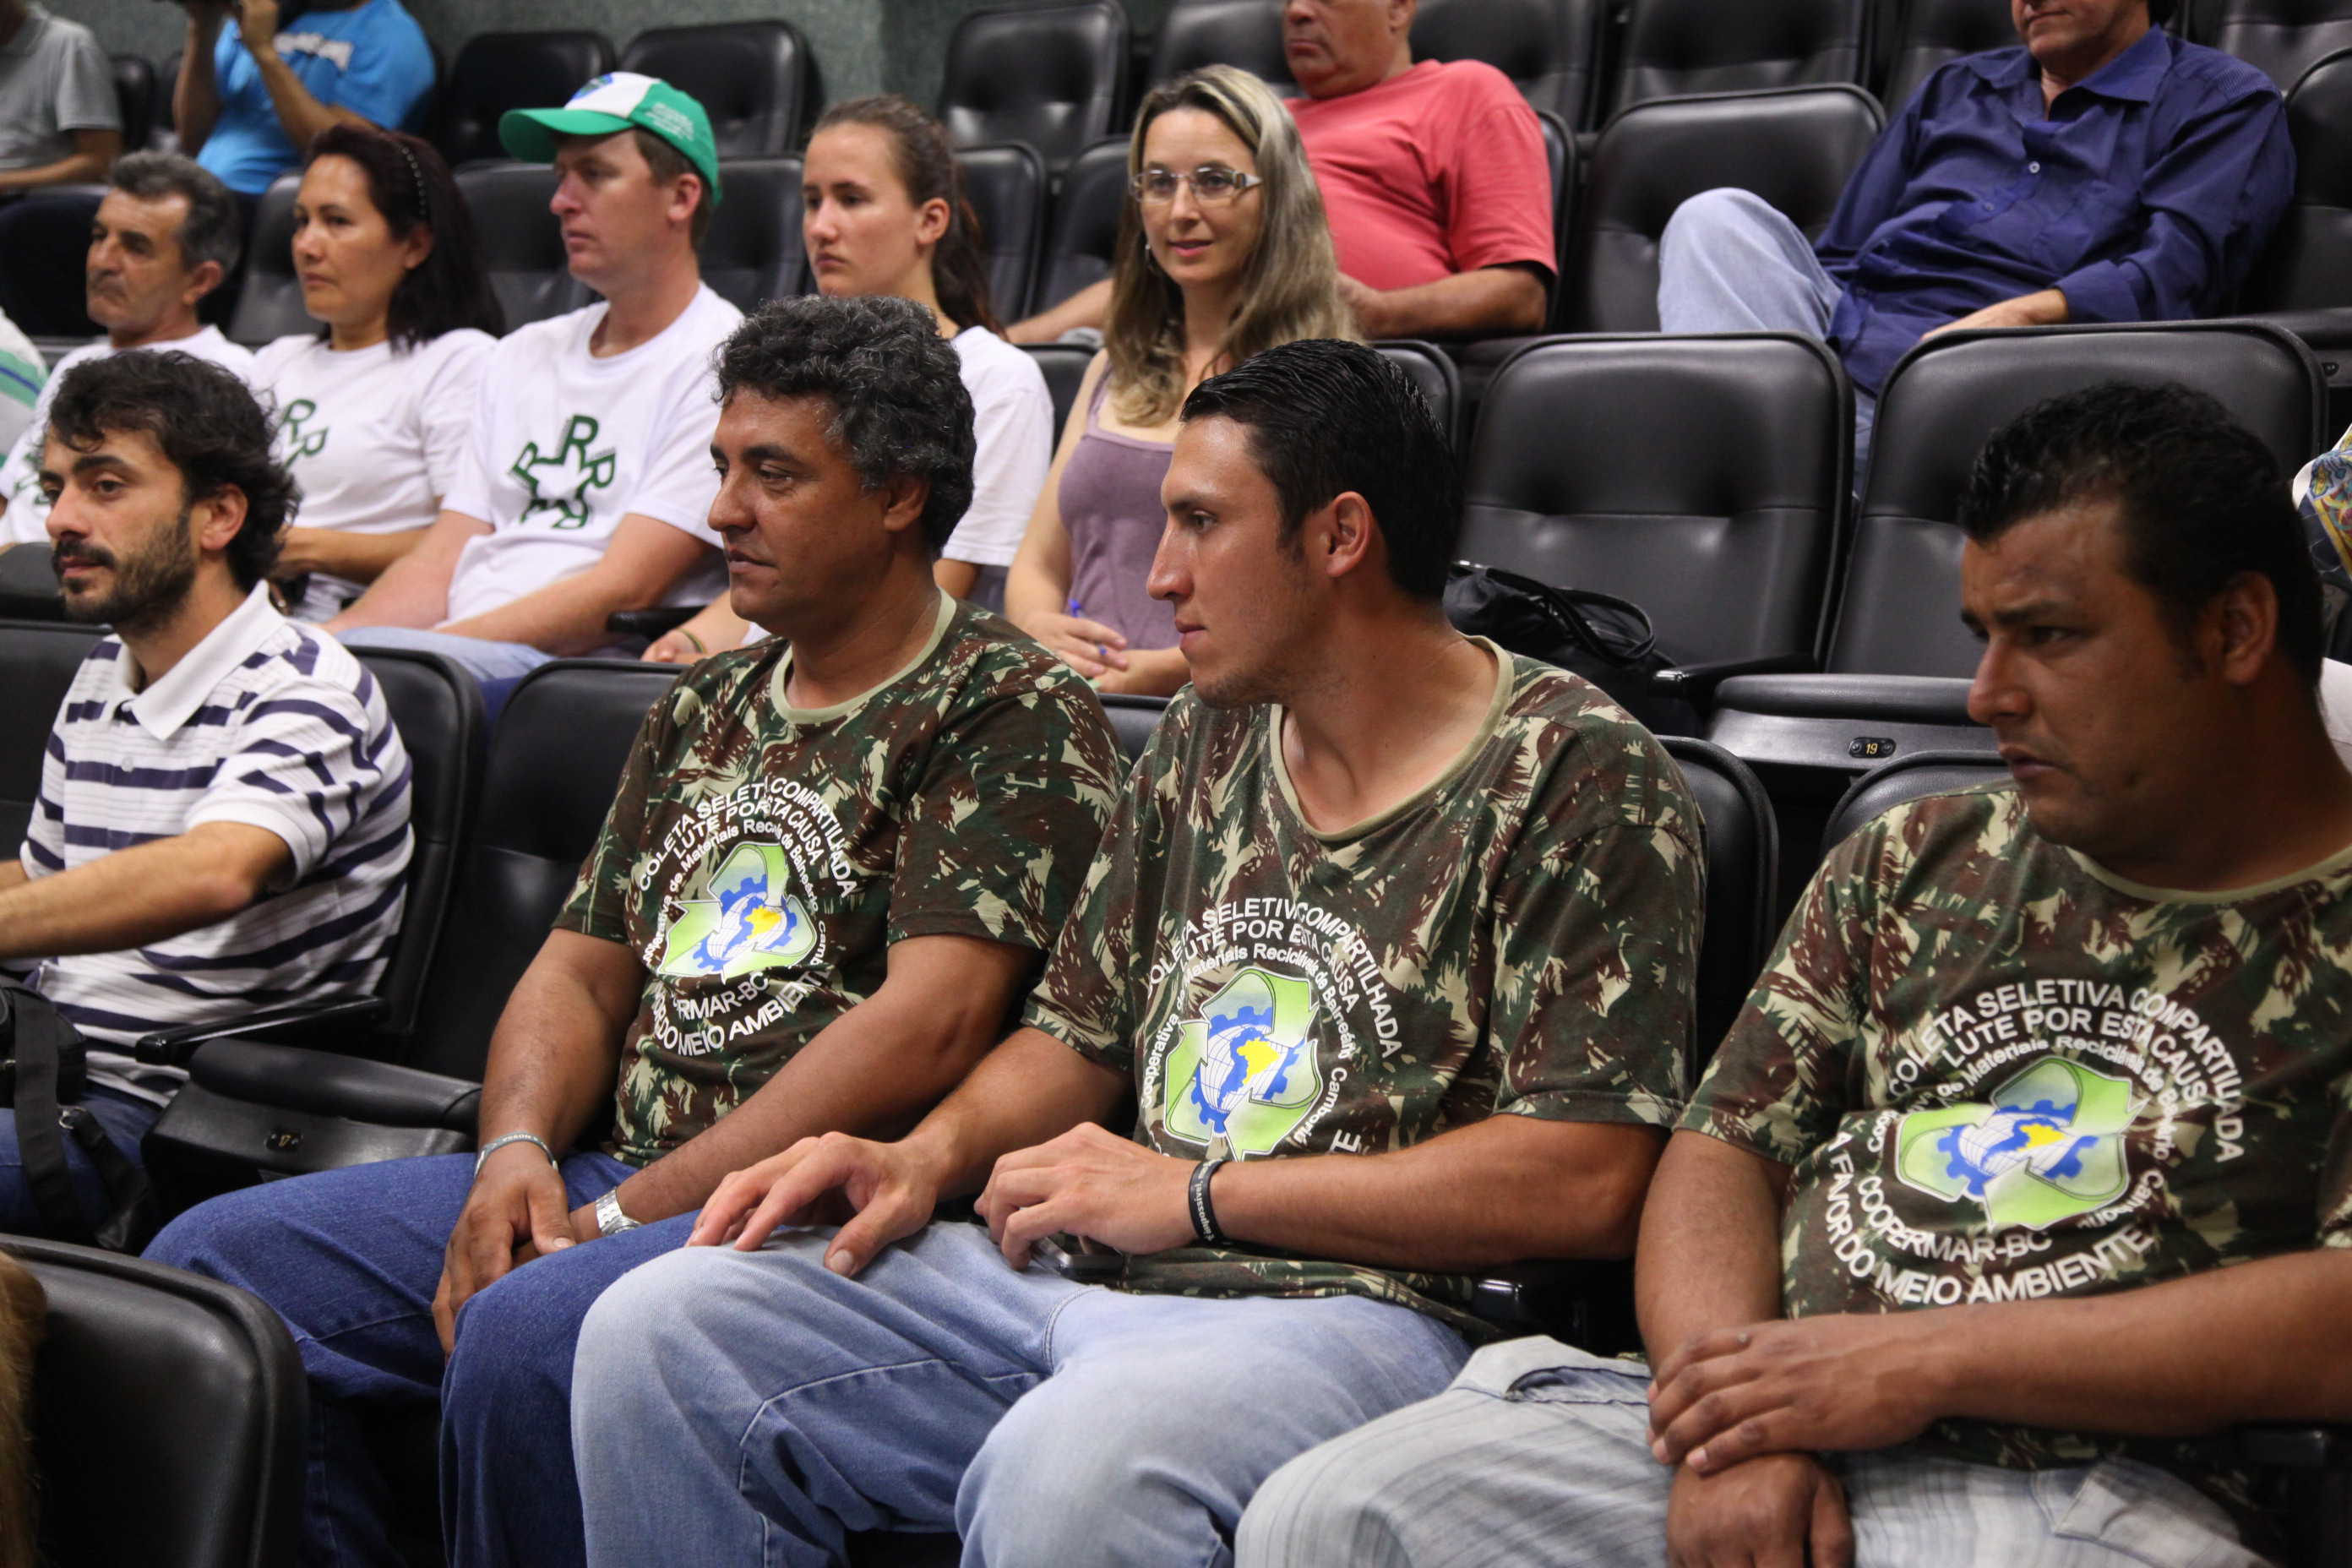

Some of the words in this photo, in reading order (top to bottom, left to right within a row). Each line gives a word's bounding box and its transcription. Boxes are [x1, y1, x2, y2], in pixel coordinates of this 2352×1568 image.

[1866, 743, 1878, 754] 19
[640, 814, 695, 891] COLETA
[673, 814, 720, 859] LUTE
[787, 810, 825, 865] CAUSA
[669, 873, 683, 892] de
[680, 825, 739, 872] Materiais
[781, 833, 793, 850] de
[789, 845, 819, 912] Balneário
[809, 921, 826, 966] Camb
[1180, 927, 1226, 972] LUTE
[1232, 920, 1284, 941] POR
[1289, 923, 1320, 956] ESTA
[1321, 941, 1359, 1014] CAUSA
[1184, 945, 1248, 988] Materiais
[1298, 902, 1402, 1058] COMPARTILHADA
[1315, 972, 1328, 990] de
[678, 1025, 725, 1056] MEIO
[1141, 1013, 1179, 1108] Cooperativa
[1889, 1005, 1977, 1097] COLETA
[1976, 979, 2126, 1017] SELETIVA
[1936, 1081, 1964, 1097] de
[1961, 1038, 2049, 1086] Materiais
[2141, 1065, 2164, 1092] de
[1942, 1015, 2017, 1068] LUTE
[2023, 1007, 2092, 1033] POR
[2100, 1011, 2155, 1048] ESTA
[1293, 1067, 1348, 1146] Camboriú
[1828, 1131, 1854, 1152] A
[1826, 1152, 1854, 1244] FAVOR
[1858, 1176, 2052, 1263] COOPERMAR-BC
[1834, 1233, 1876, 1277] DO
[1875, 1262, 1962, 1304] MEIO
[1967, 1226, 2154, 1304] AMBIENTE
